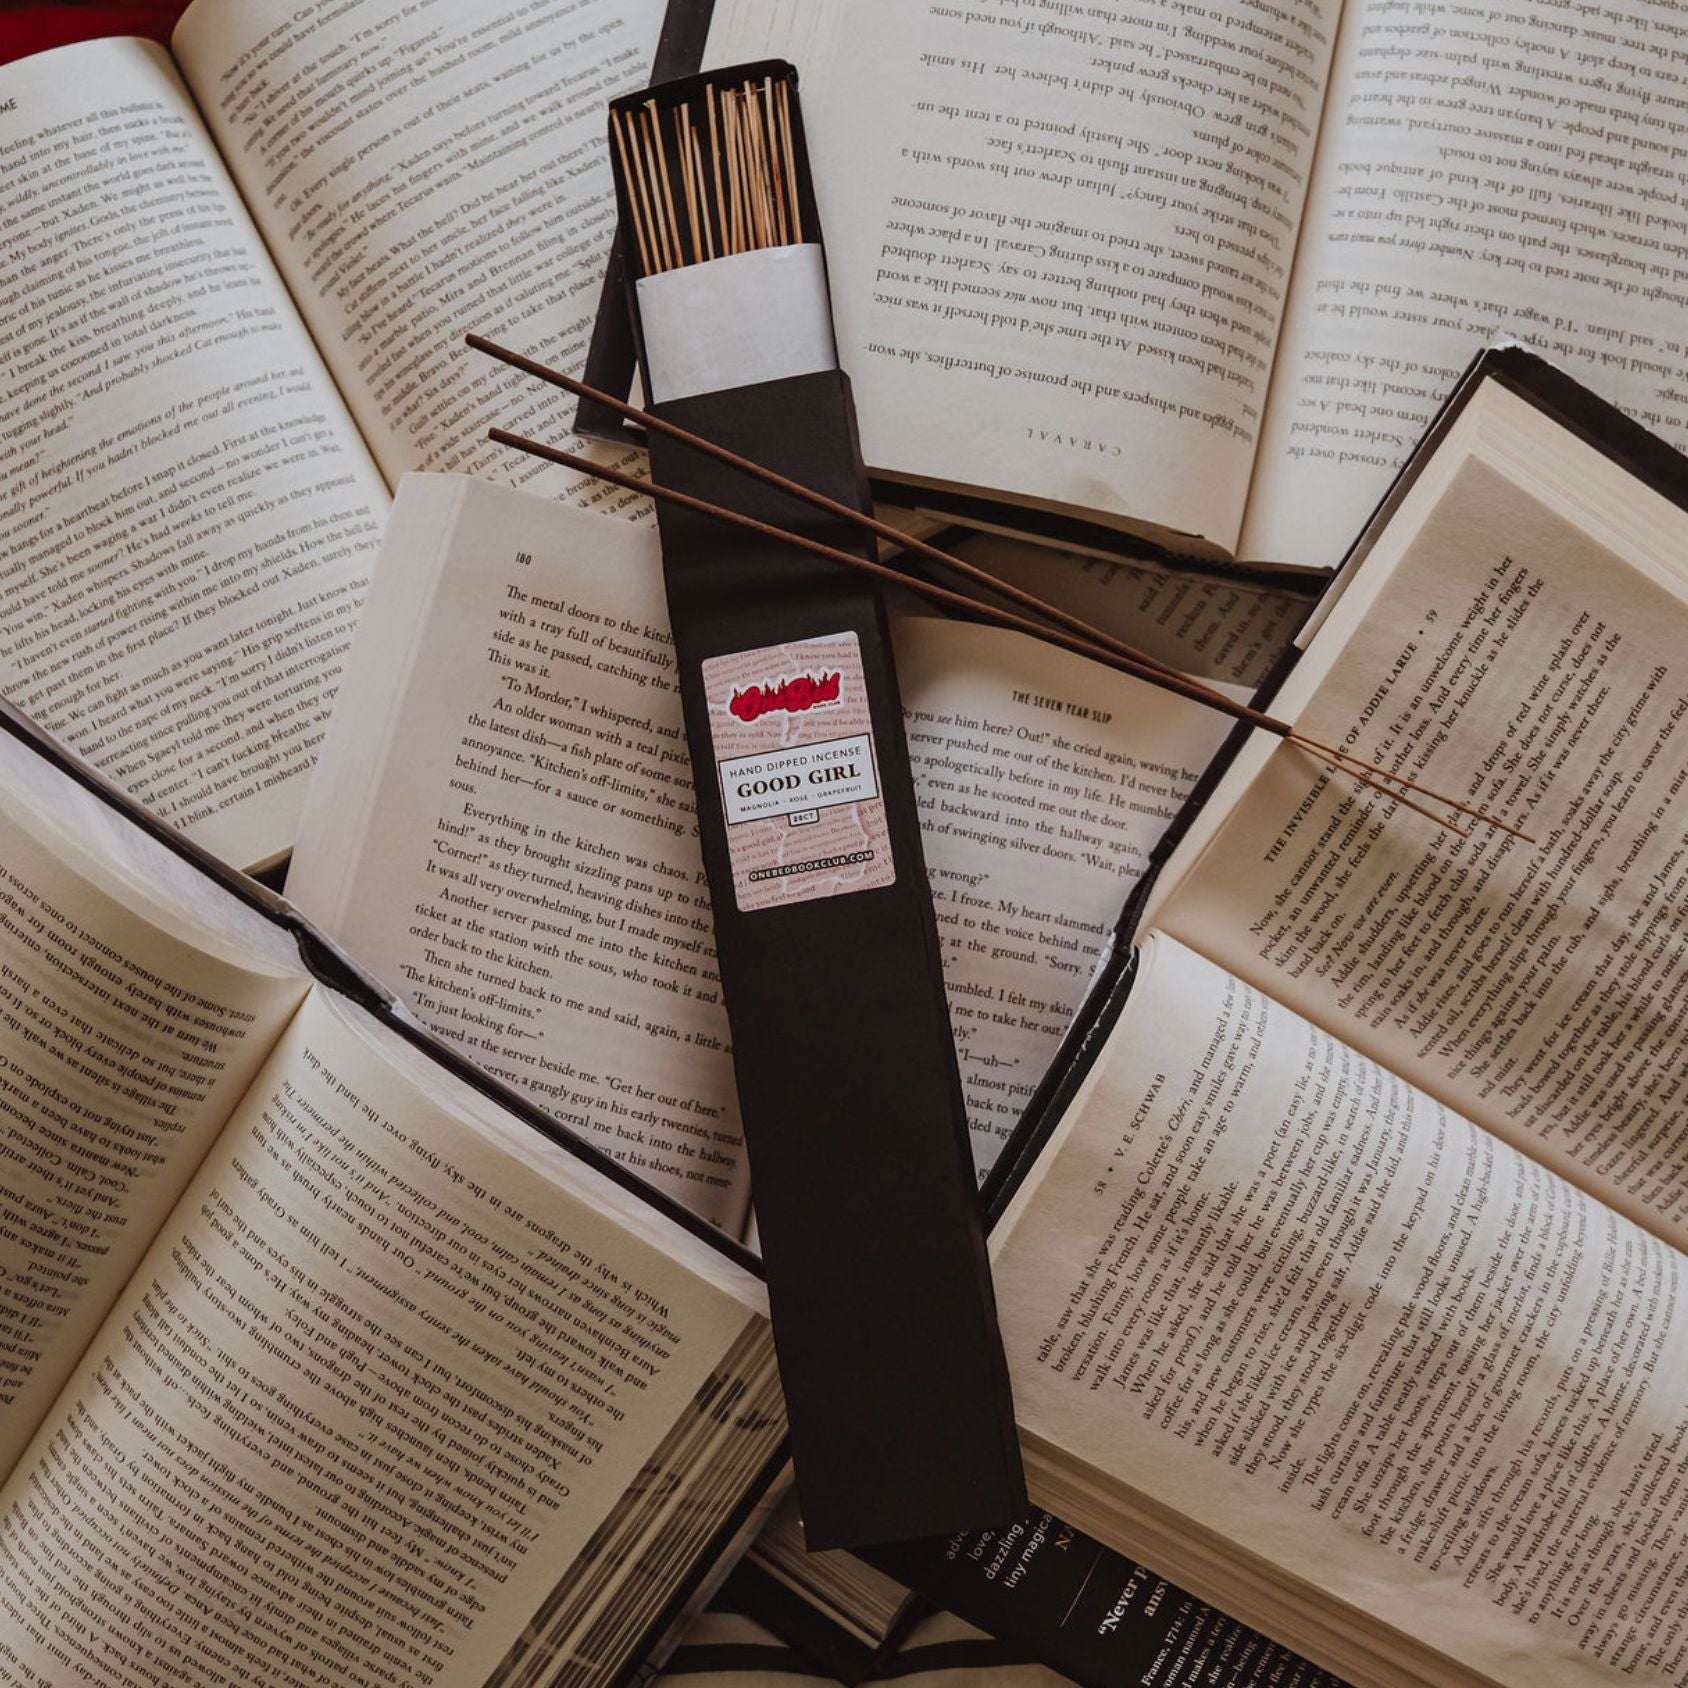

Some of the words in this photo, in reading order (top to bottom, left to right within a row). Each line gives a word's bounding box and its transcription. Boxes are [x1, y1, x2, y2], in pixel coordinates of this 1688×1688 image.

[1026, 427, 1122, 457] CARAVAL
[515, 551, 532, 566] 180
[1492, 555, 1513, 577] her
[1483, 577, 1500, 591] in
[507, 584, 528, 602] The
[530, 596, 566, 613] metal
[566, 603, 601, 624] doors
[603, 616, 617, 628] to
[619, 619, 641, 636] the
[1460, 591, 1490, 629] weight
[499, 609, 526, 625] with
[529, 619, 537, 628] a
[540, 621, 564, 639] tray
[566, 626, 590, 644] full
[591, 635, 609, 648] of
[607, 637, 674, 671] beautifully
[1420, 631, 1464, 693] unwelcome
[500, 675, 522, 693] “To
[523, 682, 580, 710] Mordor,”
[580, 698, 588, 713] I
[590, 704, 653, 734] whispered,
[656, 726, 681, 740] and
[1012, 690, 1031, 705] THE
[1033, 695, 1063, 713] SEVEN
[1065, 703, 1090, 719] YEAR
[1091, 709, 1113, 725] SLIP
[1401, 711, 1412, 723] is
[1409, 695, 1424, 711] an
[1263, 836, 1287, 863] THE
[1283, 775, 1330, 840] INVISIBLE
[1346, 725, 1362, 746] OF
[1359, 684, 1390, 727] ADDIE
[1384, 641, 1418, 685] LARUE
[1425, 608, 1440, 625] 59
[1388, 723, 1404, 736] It
[912, 711, 935, 724] you
[936, 715, 953, 725] see
[954, 713, 979, 730] him
[981, 719, 1014, 737] here?
[1016, 726, 1051, 744] Out!”
[1052, 735, 1071, 751] she
[1073, 743, 1102, 758] cried
[1103, 751, 1137, 769] again,
[1139, 760, 1179, 781] waving
[1180, 767, 1199, 783] her
[1373, 746, 1385, 766] of
[1382, 739, 1396, 751] it.
[729, 764, 763, 779] HAND
[766, 756, 808, 772] DIPPED
[811, 745, 861, 763] INCENSE
[180, 816, 187, 827] I
[188, 805, 218, 824] blink,
[218, 787, 256, 810] certain
[255, 780, 262, 792] I
[263, 759, 309, 789] misheard
[737, 774, 801, 798] GOOD
[808, 763, 861, 785] GIRL
[740, 800, 780, 812] MAGNOLIA
[817, 784, 862, 798] GRAPEFRUIT
[1338, 796, 1356, 816] the
[1317, 815, 1342, 849] stand
[749, 850, 875, 882] ONEBEDBOOKCLUB.COM
[1290, 848, 1320, 887] cannot
[1274, 887, 1292, 908] she
[1248, 910, 1279, 936] Now,
[1093, 1181, 1108, 1196] 58
[1113, 1147, 1128, 1157] V.
[1122, 1134, 1135, 1145] E.
[1129, 1073, 1166, 1131] SCHWAB
[408, 1138, 442, 1169] flying
[443, 1163, 466, 1184] sky,
[466, 1181, 487, 1200] the
[488, 1195, 503, 1209] in
[504, 1206, 524, 1222] are
[524, 1219, 572, 1253] dragons
[1036, 1333, 1063, 1364] table,
[1057, 1306, 1074, 1330] saw
[1069, 1280, 1090, 1305] that
[1084, 1258, 1103, 1279] she
[1098, 1233, 1117, 1256] was
[1112, 1186, 1147, 1233] reading
[1136, 1134, 1174, 1185] Colette's
[1167, 1098, 1194, 1132] Chéri,
[573, 1250, 593, 1268] the
[594, 1263, 618, 1284] why
[621, 1280, 633, 1294] is
[634, 1288, 669, 1319] Which
[1462, 1547, 1492, 1590] retreats
[1487, 1533, 1500, 1547] to
[1495, 1513, 1513, 1533] the
[1509, 1477, 1534, 1513] cream
[1531, 1451, 1551, 1477] sofa,
[1003, 1562, 1027, 1588] tiny
[1140, 1648, 1171, 1688] France,
